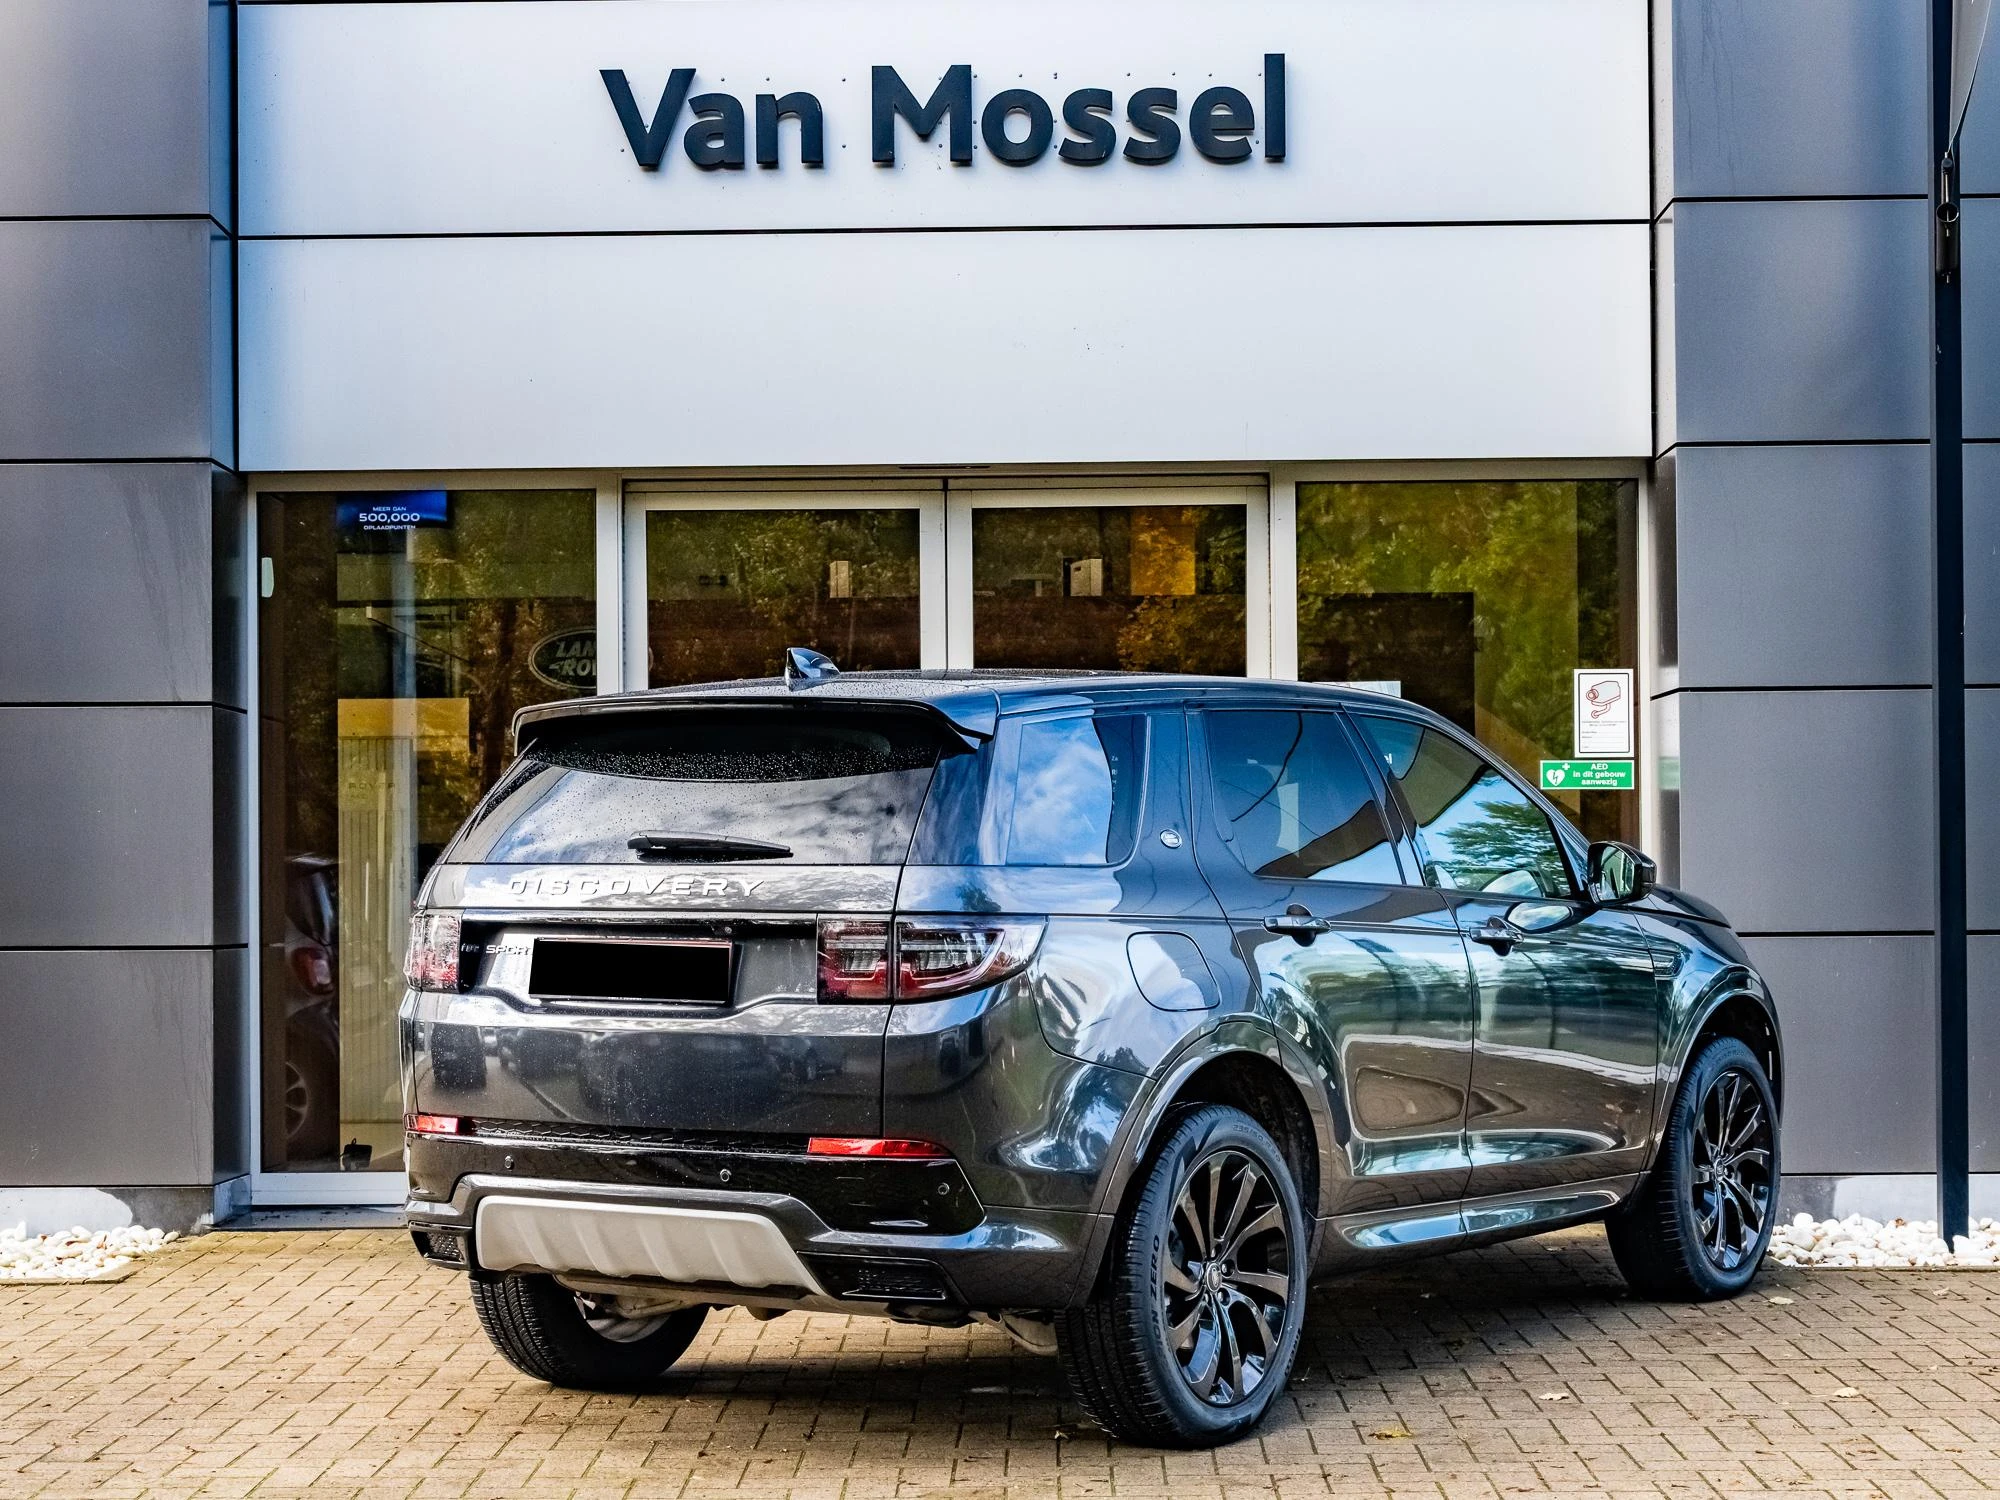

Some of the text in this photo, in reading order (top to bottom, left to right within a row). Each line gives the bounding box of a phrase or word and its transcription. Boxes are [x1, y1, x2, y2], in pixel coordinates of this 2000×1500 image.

[599, 52, 1288, 170] Van Mossel
[359, 513, 420, 524] 500,000
[555, 640, 597, 658] LAN
[1590, 763, 1609, 771] AED
[1572, 770, 1626, 779] in dit gebouw
[1581, 779, 1618, 787] aanwezig
[509, 875, 765, 898] DISCOVERY
[485, 944, 533, 956] SPOR
[1150, 1234, 1160, 1301] ZERO
